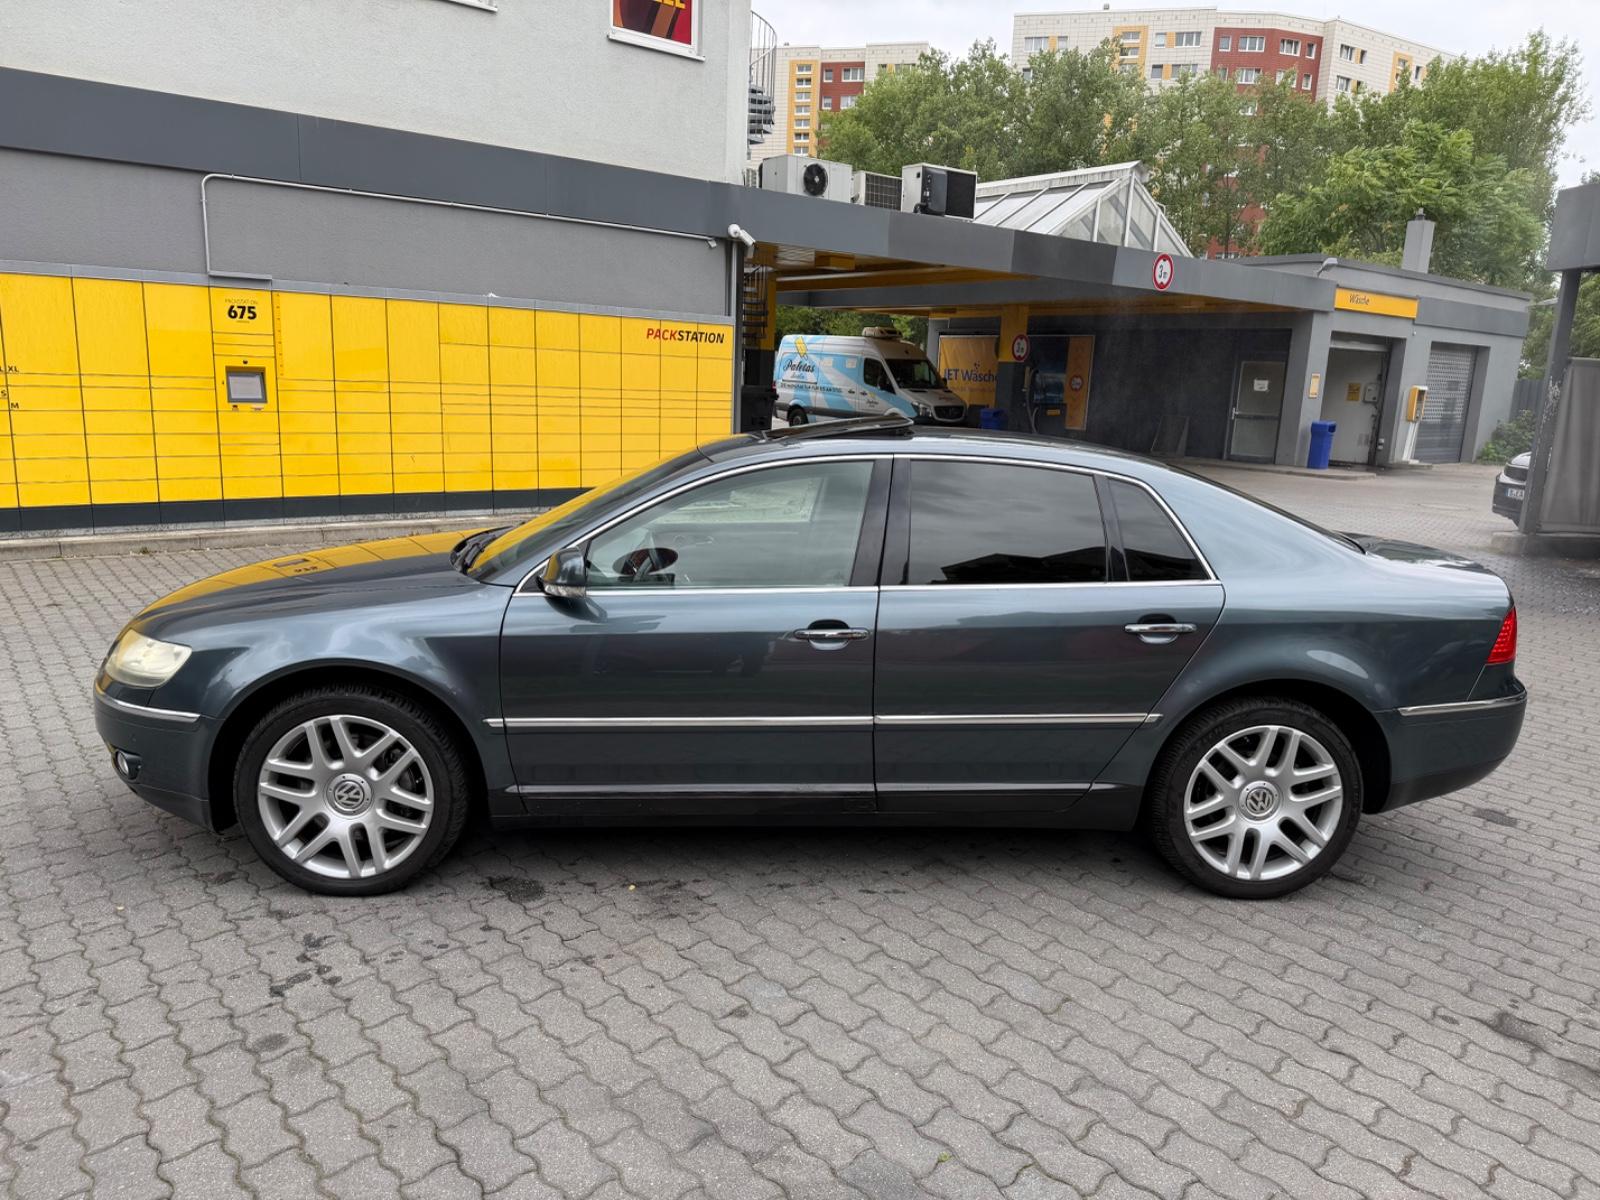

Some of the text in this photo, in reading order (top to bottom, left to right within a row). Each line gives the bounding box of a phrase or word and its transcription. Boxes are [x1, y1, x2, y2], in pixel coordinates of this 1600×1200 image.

[228, 305, 257, 320] 675
[646, 328, 725, 344] PACKSTATION
[8, 365, 19, 373] XL
